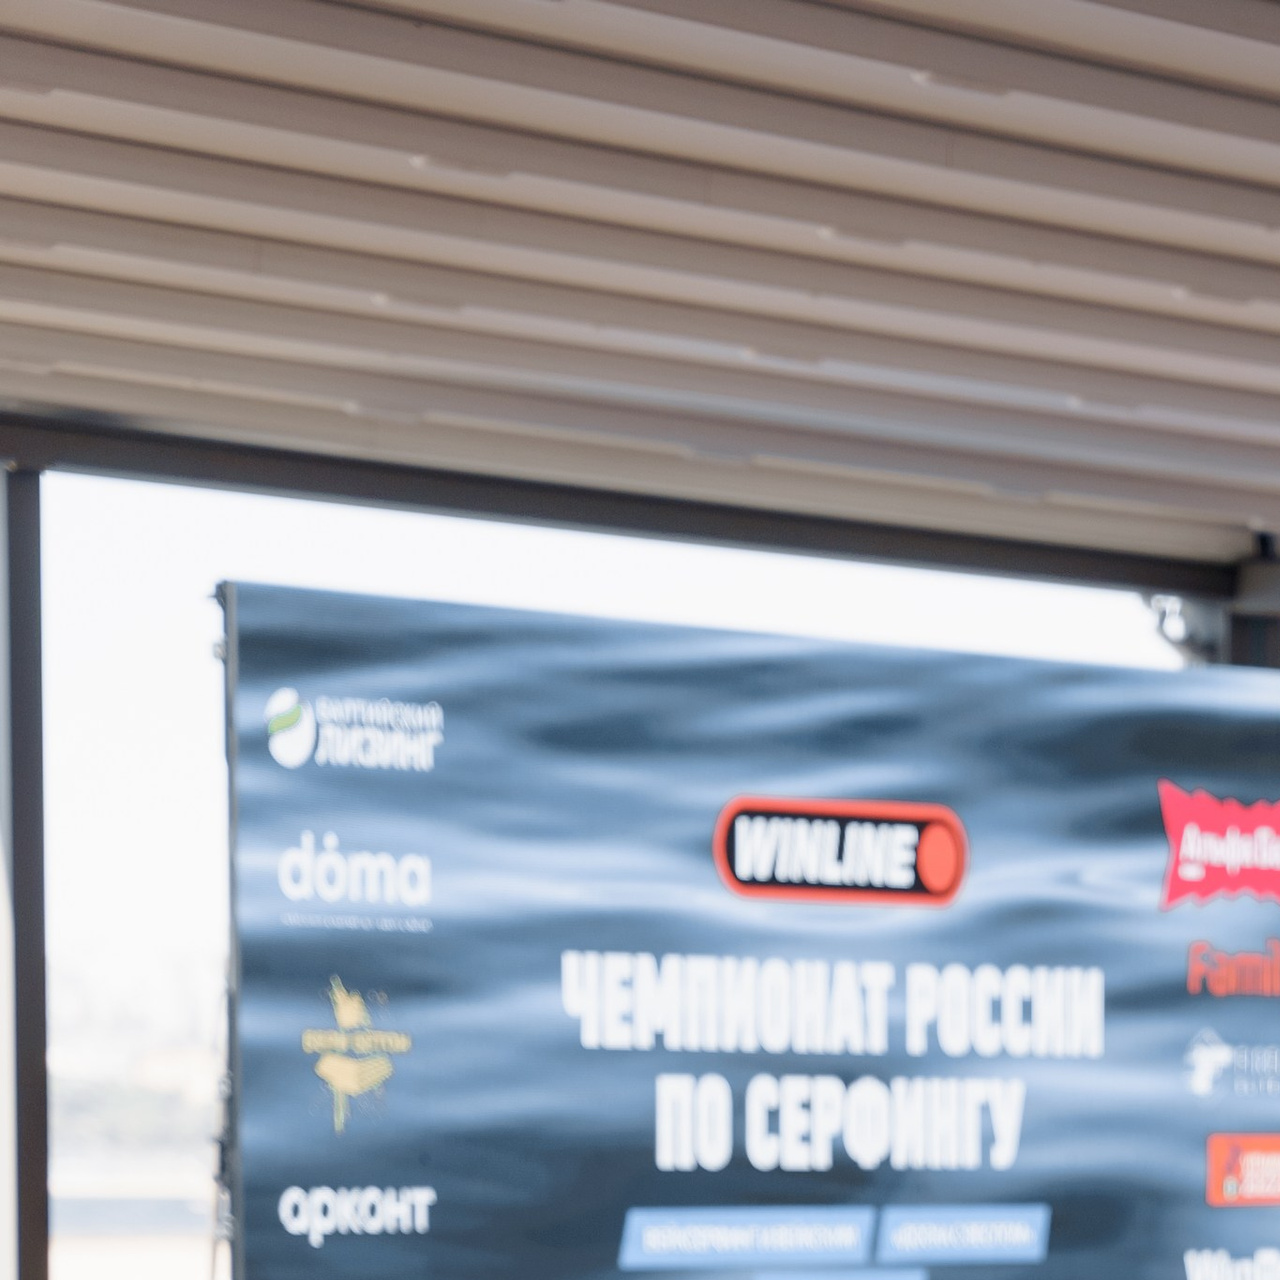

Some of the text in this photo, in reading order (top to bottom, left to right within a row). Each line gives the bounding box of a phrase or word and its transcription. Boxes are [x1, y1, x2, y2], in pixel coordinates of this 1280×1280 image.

[735, 815, 919, 889] WINLINE
[561, 950, 1104, 1058] ЧЕМПИОНАТ РОССИИ
[655, 1073, 1027, 1171] ПО СЕРФИНГУ
